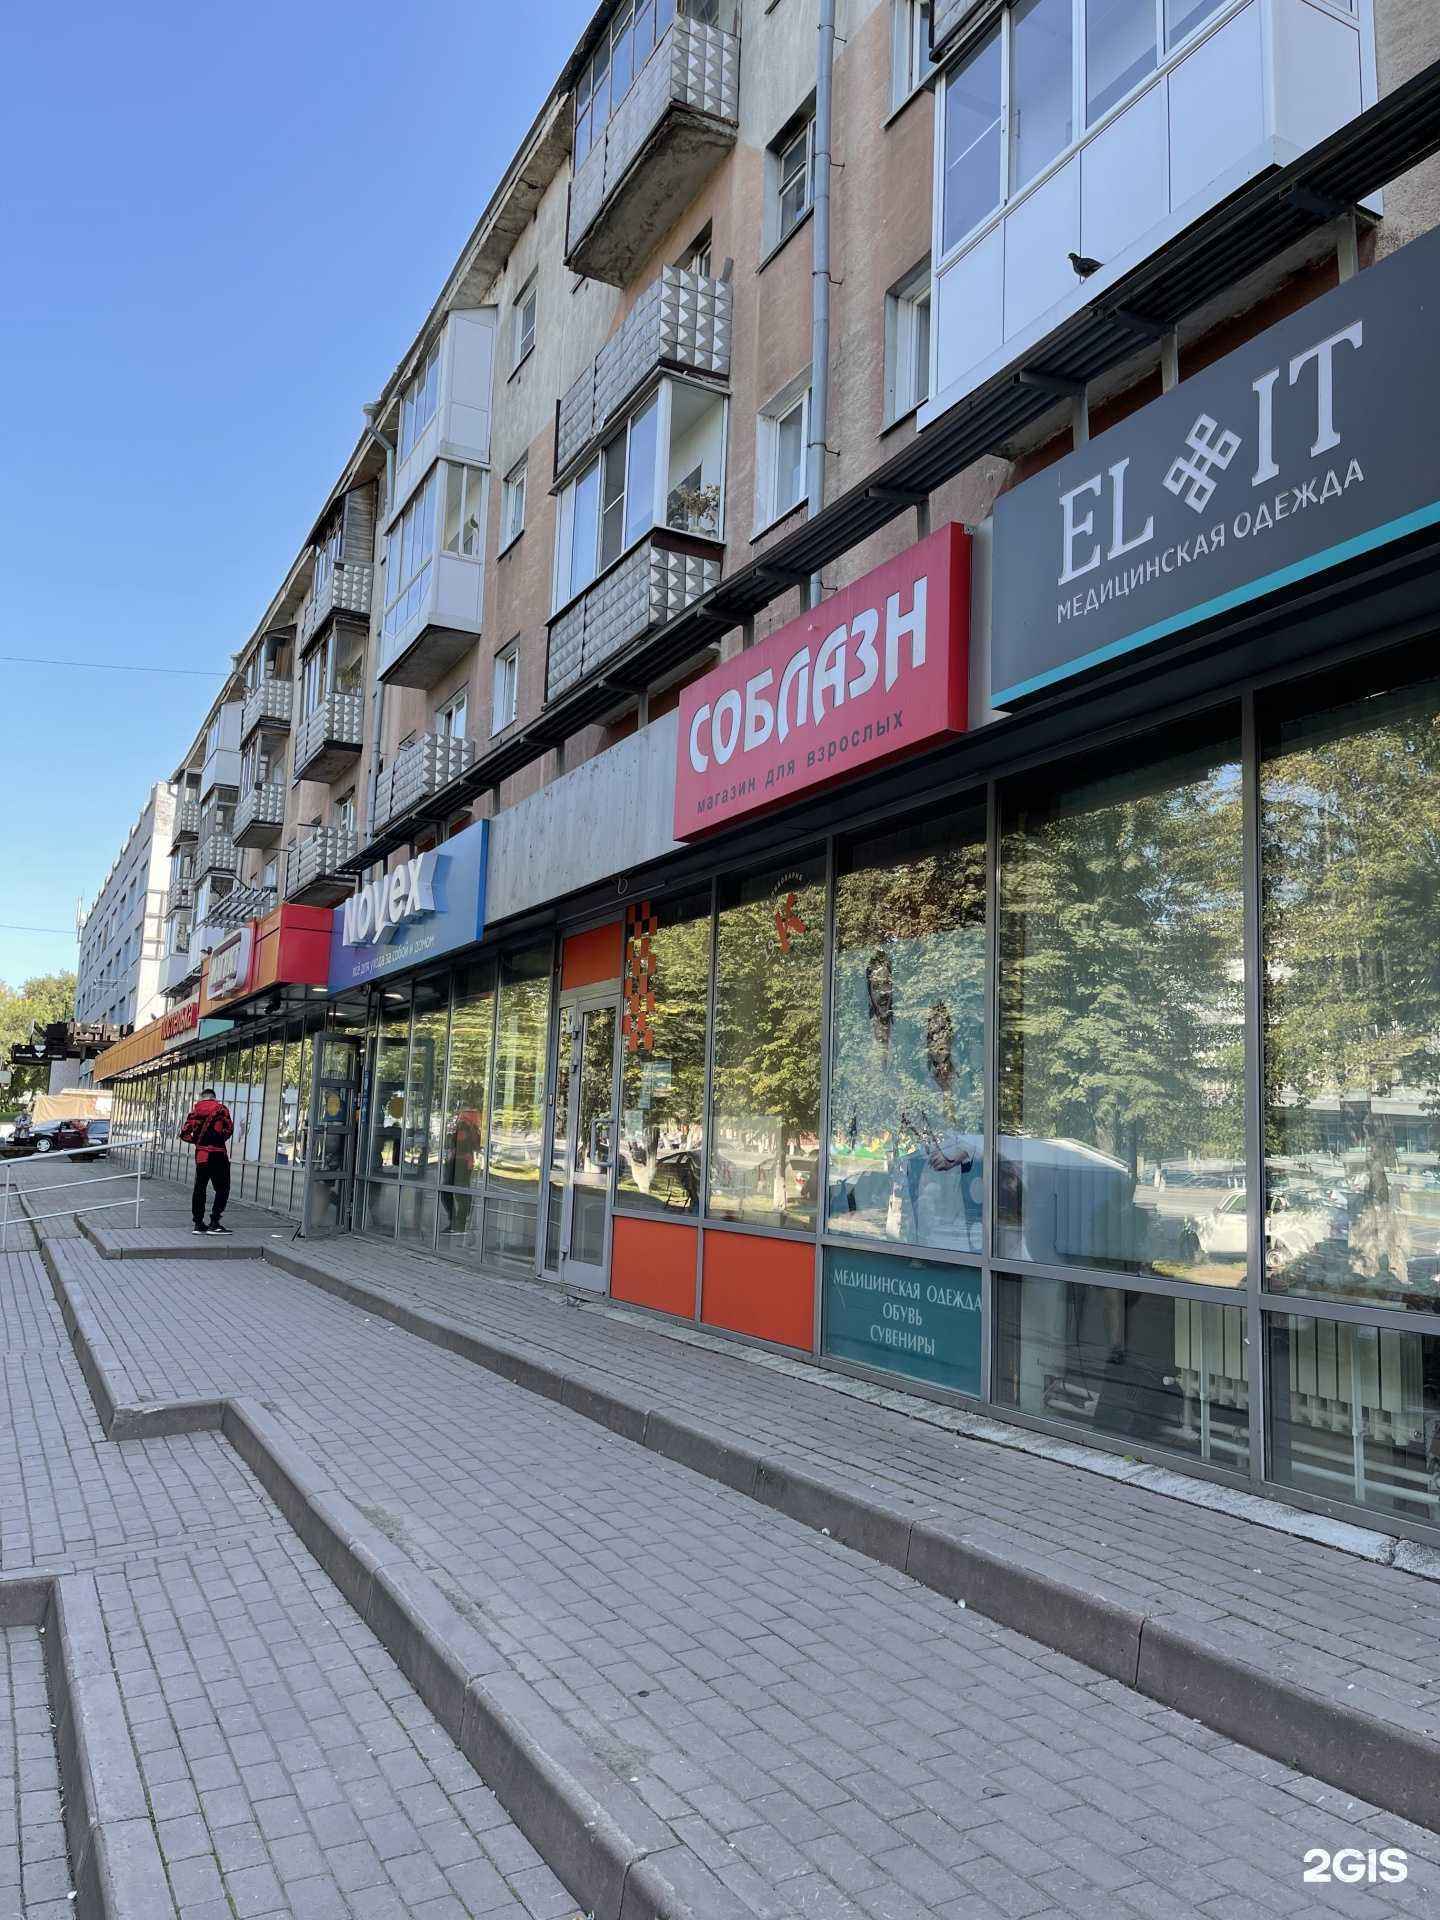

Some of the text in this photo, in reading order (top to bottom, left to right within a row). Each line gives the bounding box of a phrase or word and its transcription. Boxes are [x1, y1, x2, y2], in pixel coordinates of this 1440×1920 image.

[1056, 457, 1365, 624] МЕДИЦИНСКАЯ ОДЕЖДА
[688, 575, 928, 775] СОБЛАЗН
[697, 710, 904, 813] магазин для взрослых
[833, 1268, 982, 1312] МЕДИЦИНСКАЯ ОДЕЖДА
[882, 1302, 923, 1326] ОБУВЬ
[870, 1324, 935, 1356] СУВЕНИРЫ
